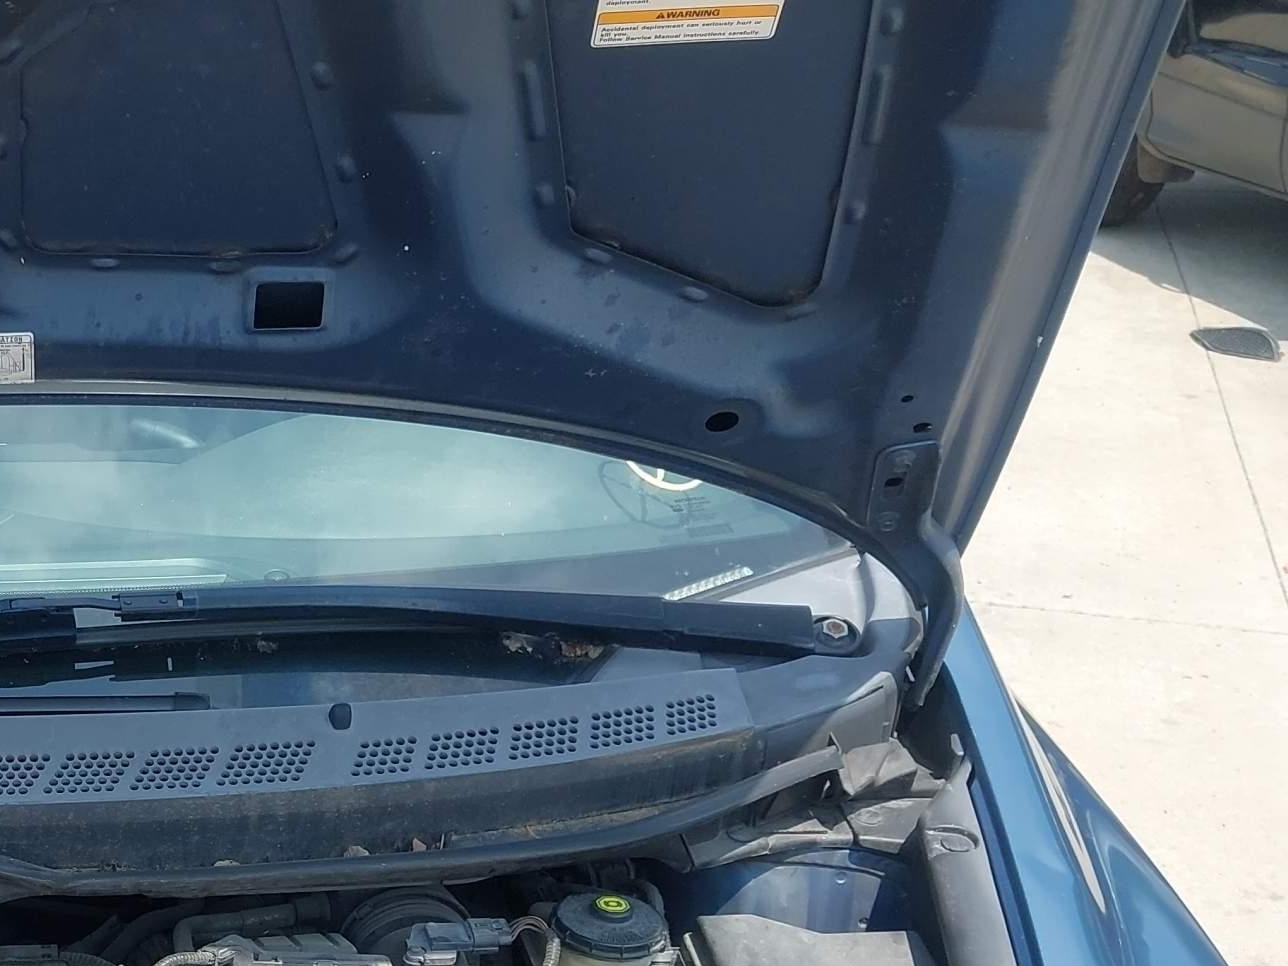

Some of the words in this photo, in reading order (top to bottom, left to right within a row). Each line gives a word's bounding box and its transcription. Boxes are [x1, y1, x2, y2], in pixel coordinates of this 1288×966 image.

[666, 9, 720, 18] WARNING
[641, 23, 684, 31] deployment
[702, 20, 734, 28] seriously
